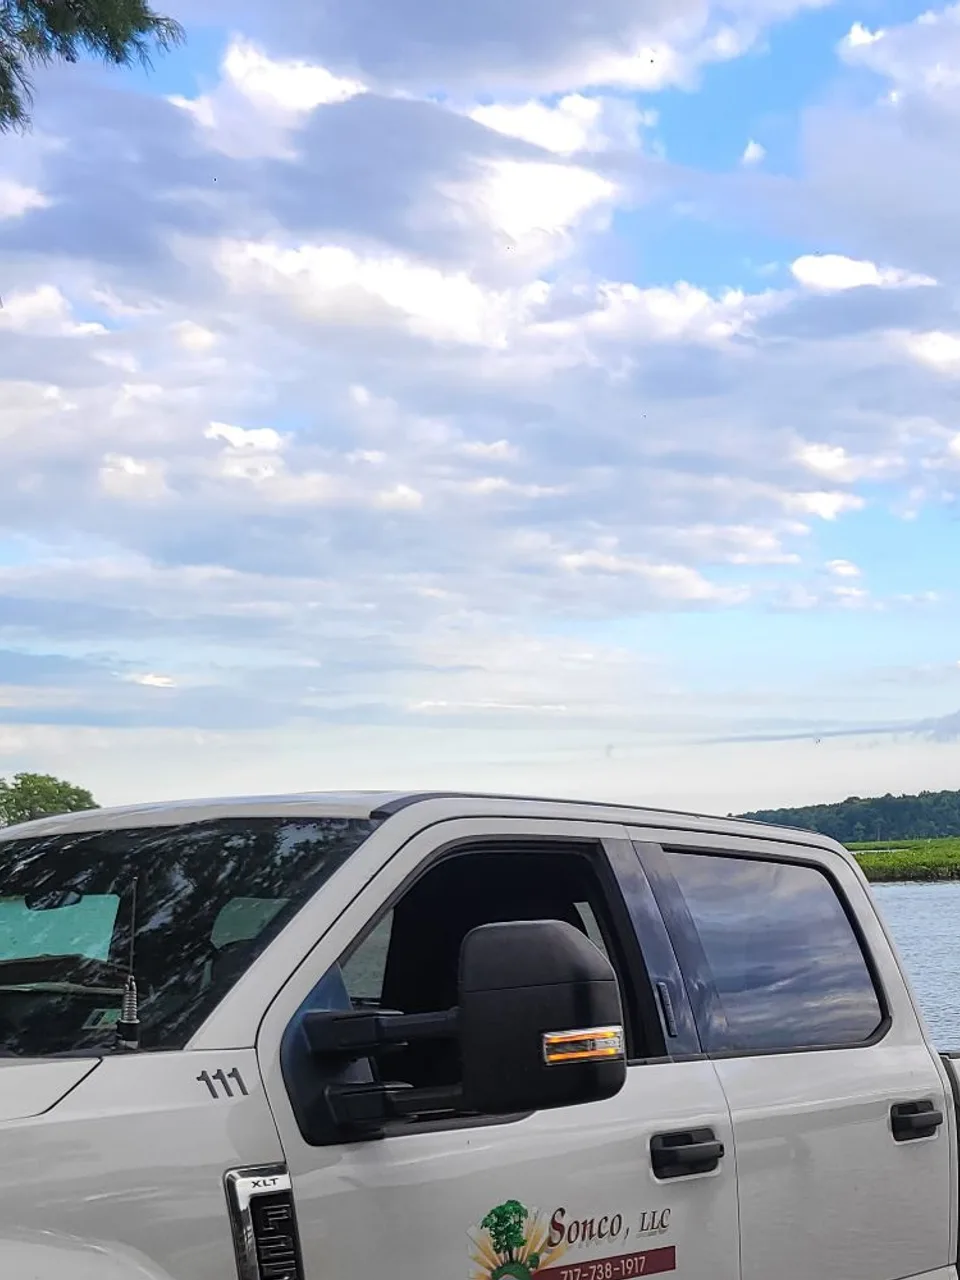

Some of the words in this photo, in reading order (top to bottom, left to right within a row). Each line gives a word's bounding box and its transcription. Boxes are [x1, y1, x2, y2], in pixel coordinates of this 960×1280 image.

[196, 1067, 250, 1100] 111
[251, 1177, 280, 1189] XLT
[547, 1206, 630, 1248] Sonco,
[638, 1208, 671, 1233] LLC
